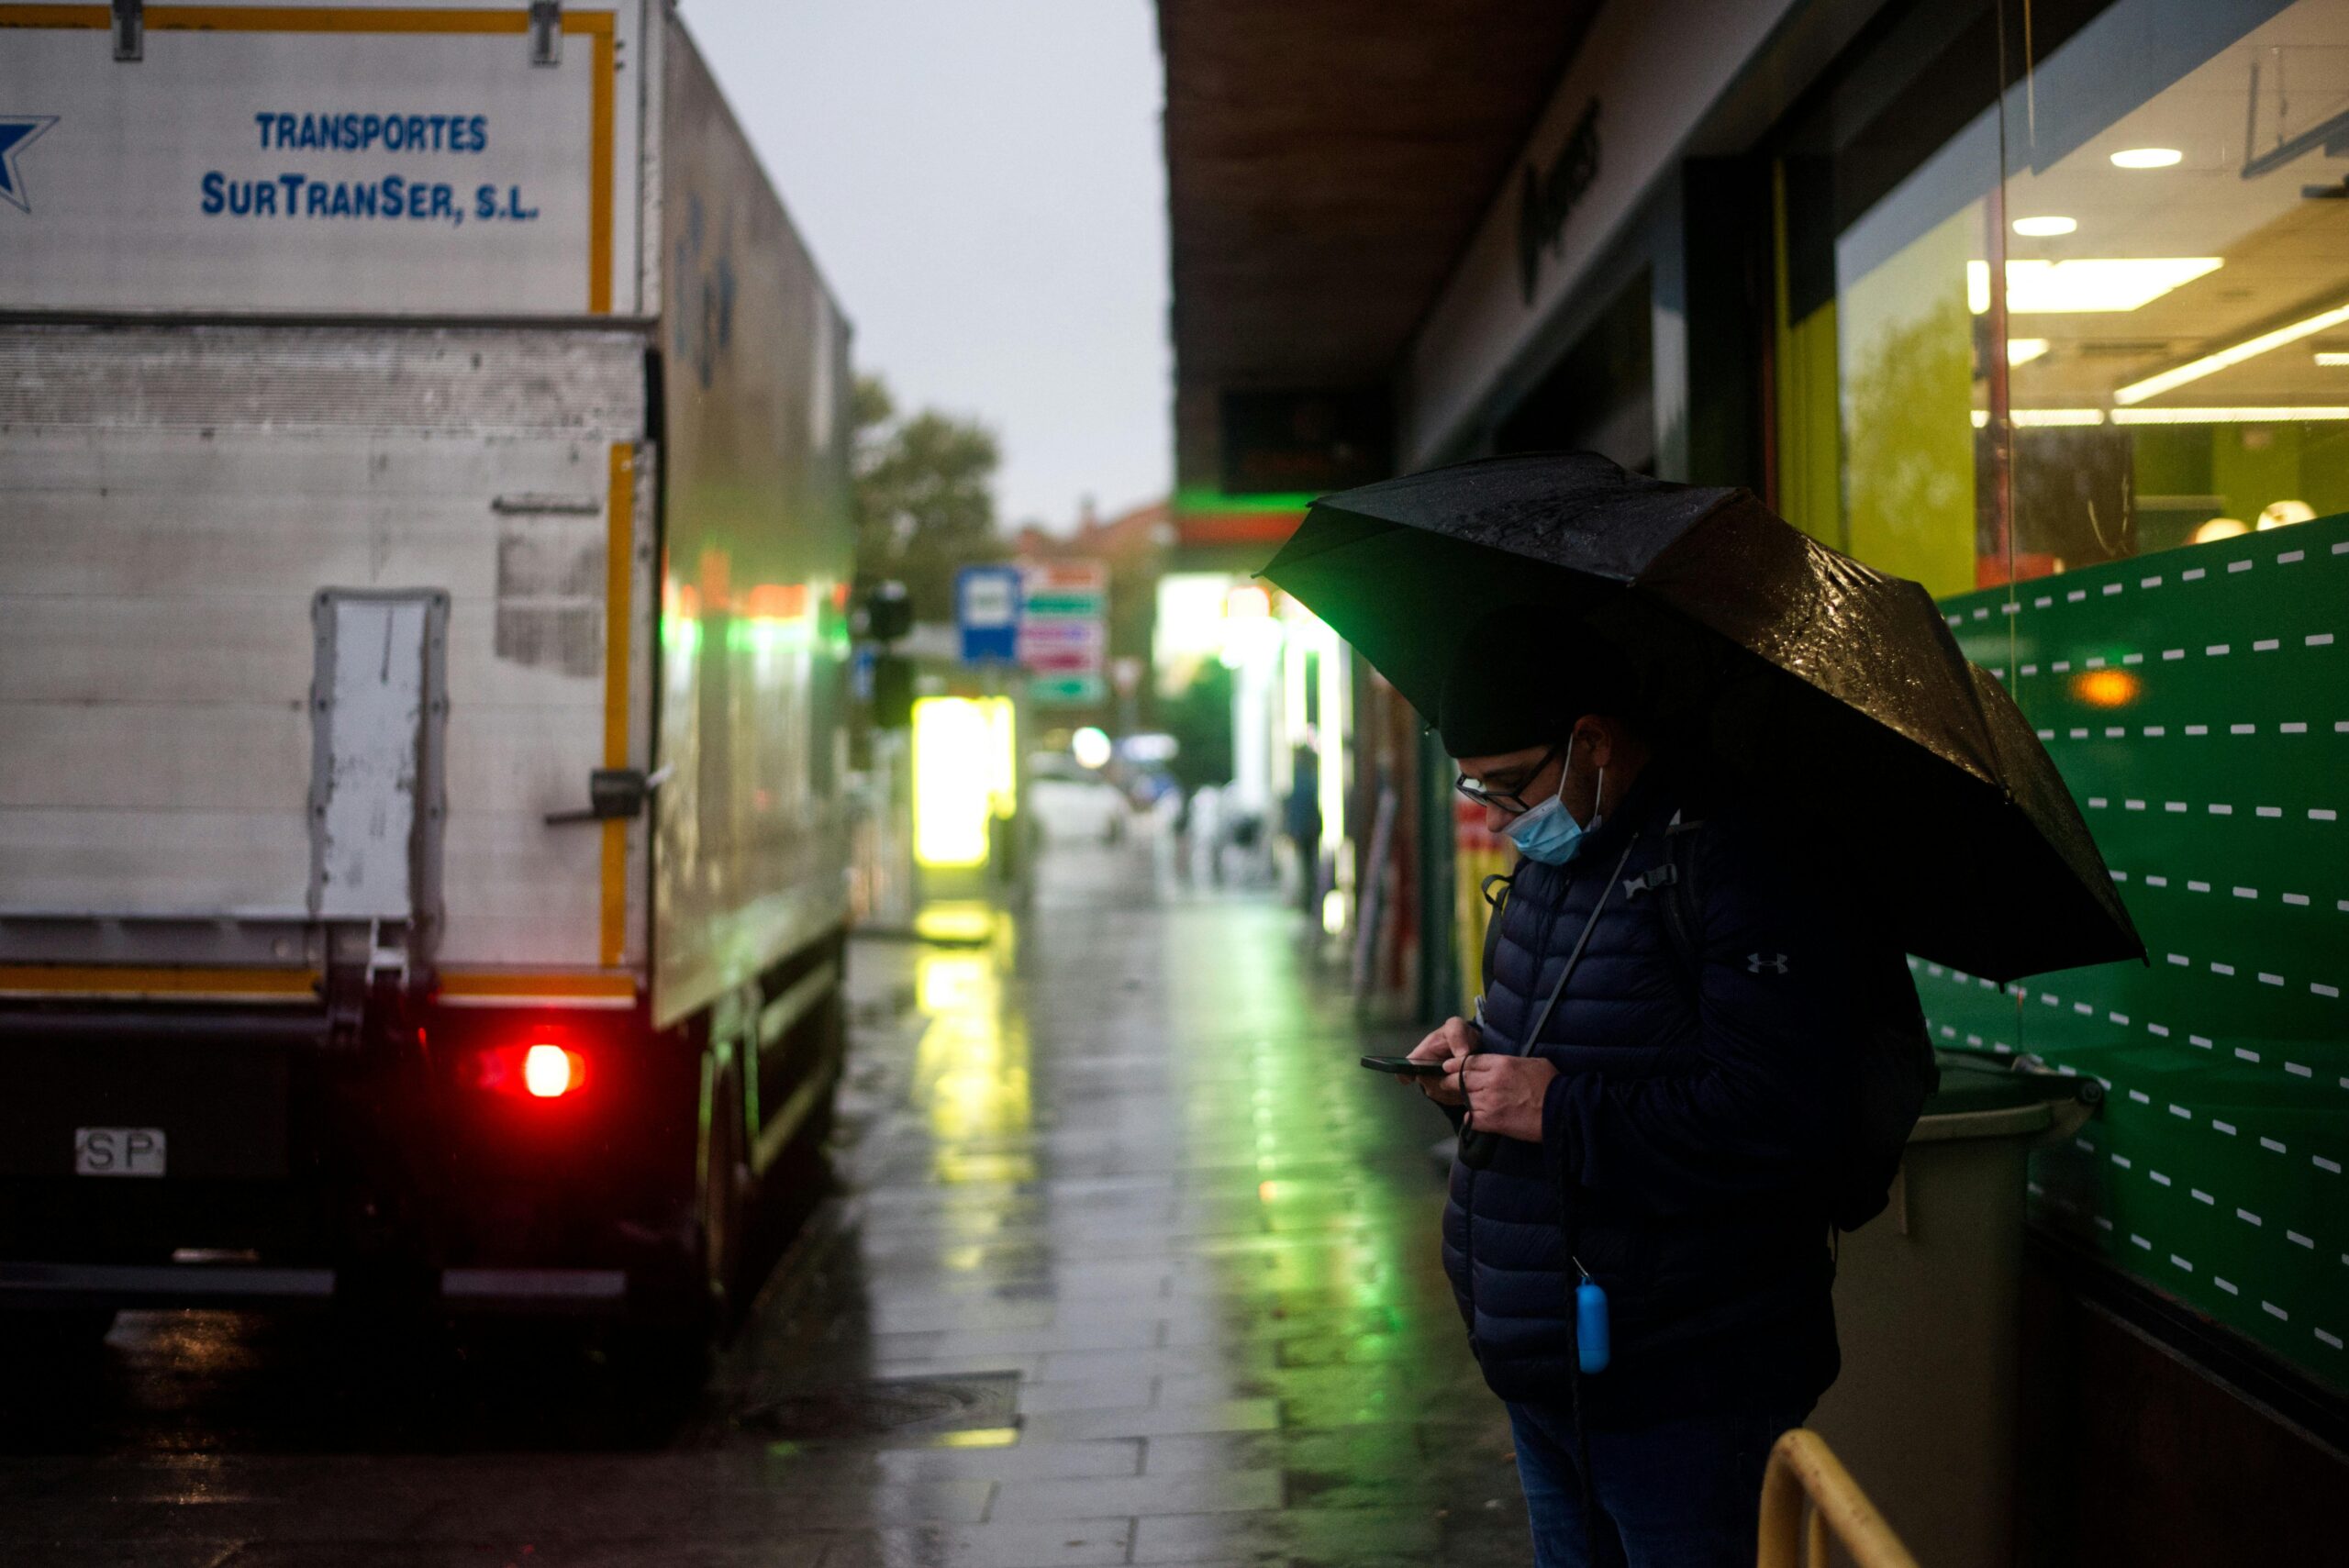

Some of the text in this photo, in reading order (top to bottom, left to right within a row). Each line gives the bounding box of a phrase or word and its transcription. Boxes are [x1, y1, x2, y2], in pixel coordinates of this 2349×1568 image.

[254, 111, 488, 154] TRANSPORTES
[474, 183, 540, 221] S.L.
[87, 1131, 154, 1171] SP
